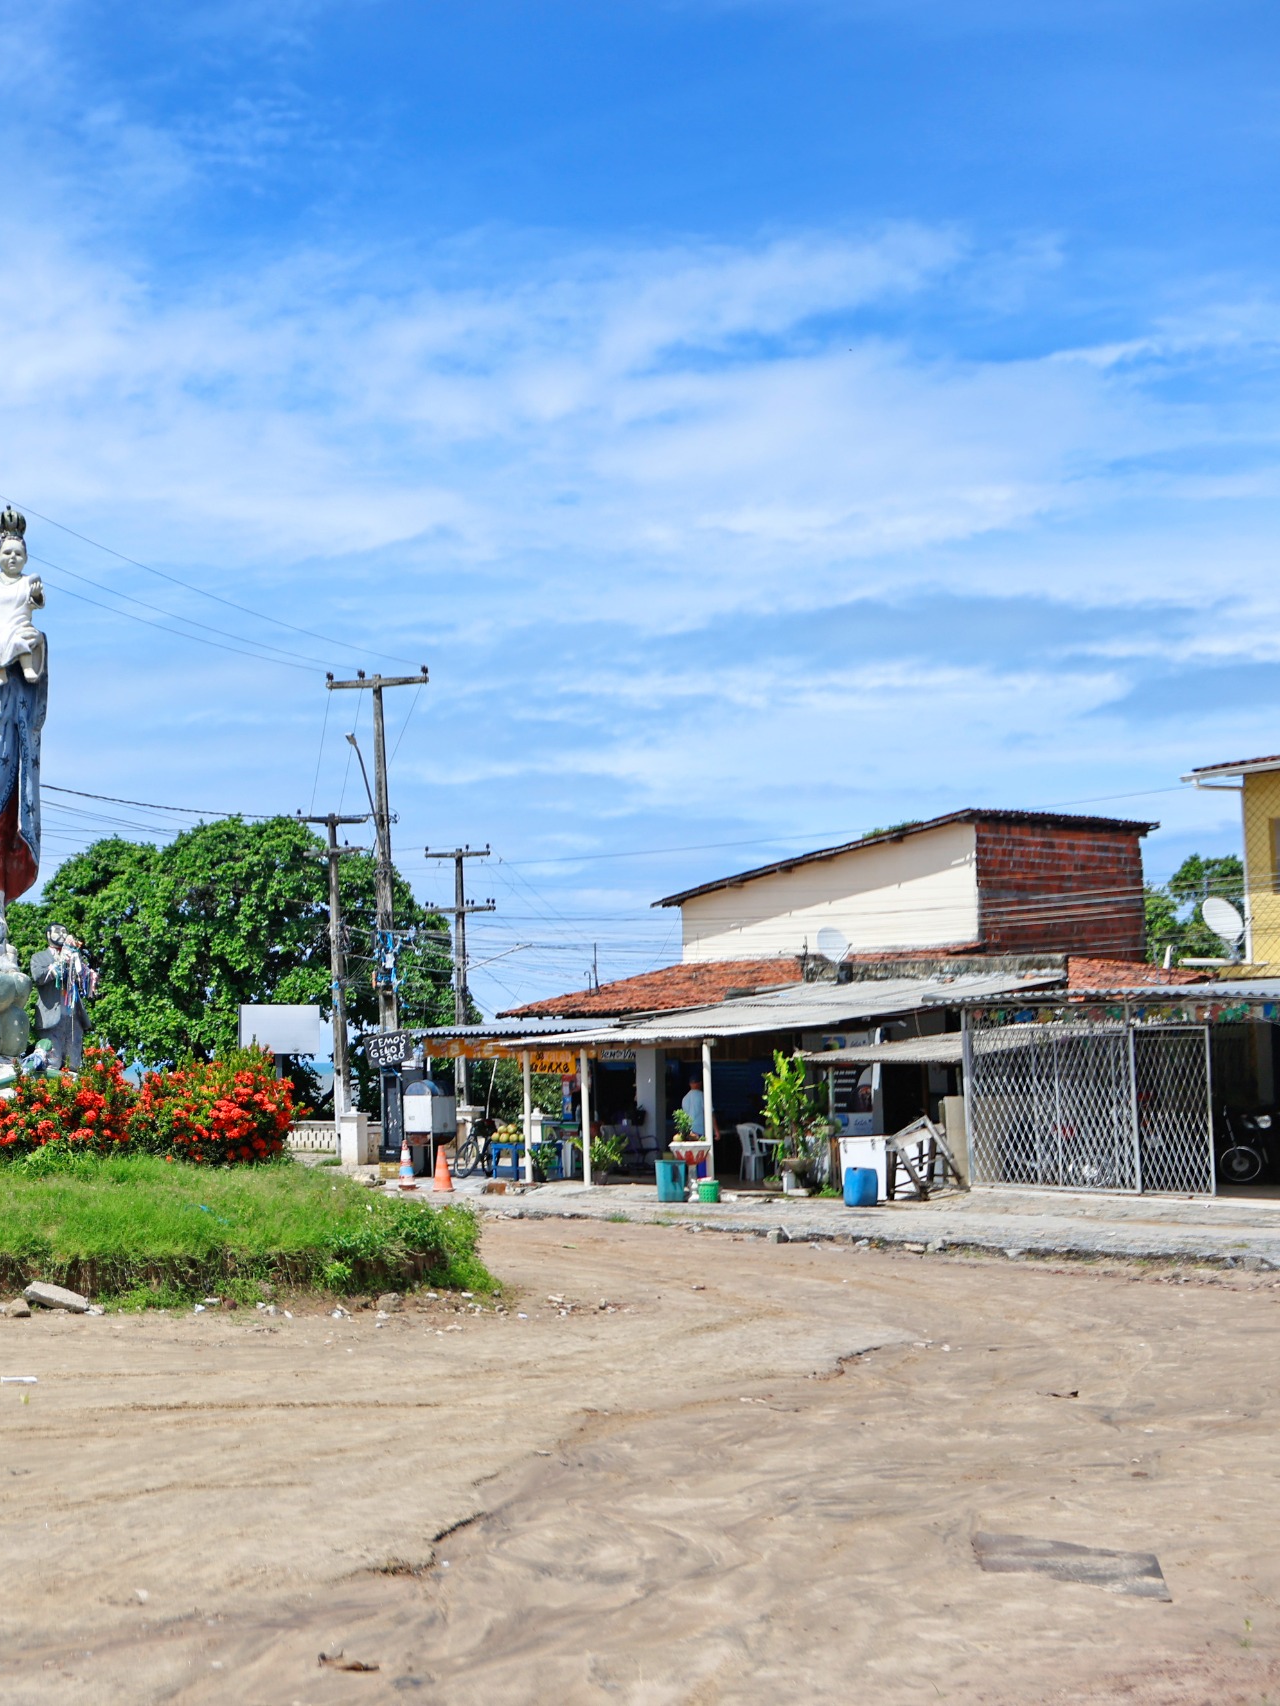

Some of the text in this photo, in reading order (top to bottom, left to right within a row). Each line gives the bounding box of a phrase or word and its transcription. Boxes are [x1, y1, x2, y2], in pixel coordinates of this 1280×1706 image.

[369, 1034, 406, 1050] TEMOS
[371, 1046, 397, 1058] GELO
[379, 1051, 405, 1065] COCO
